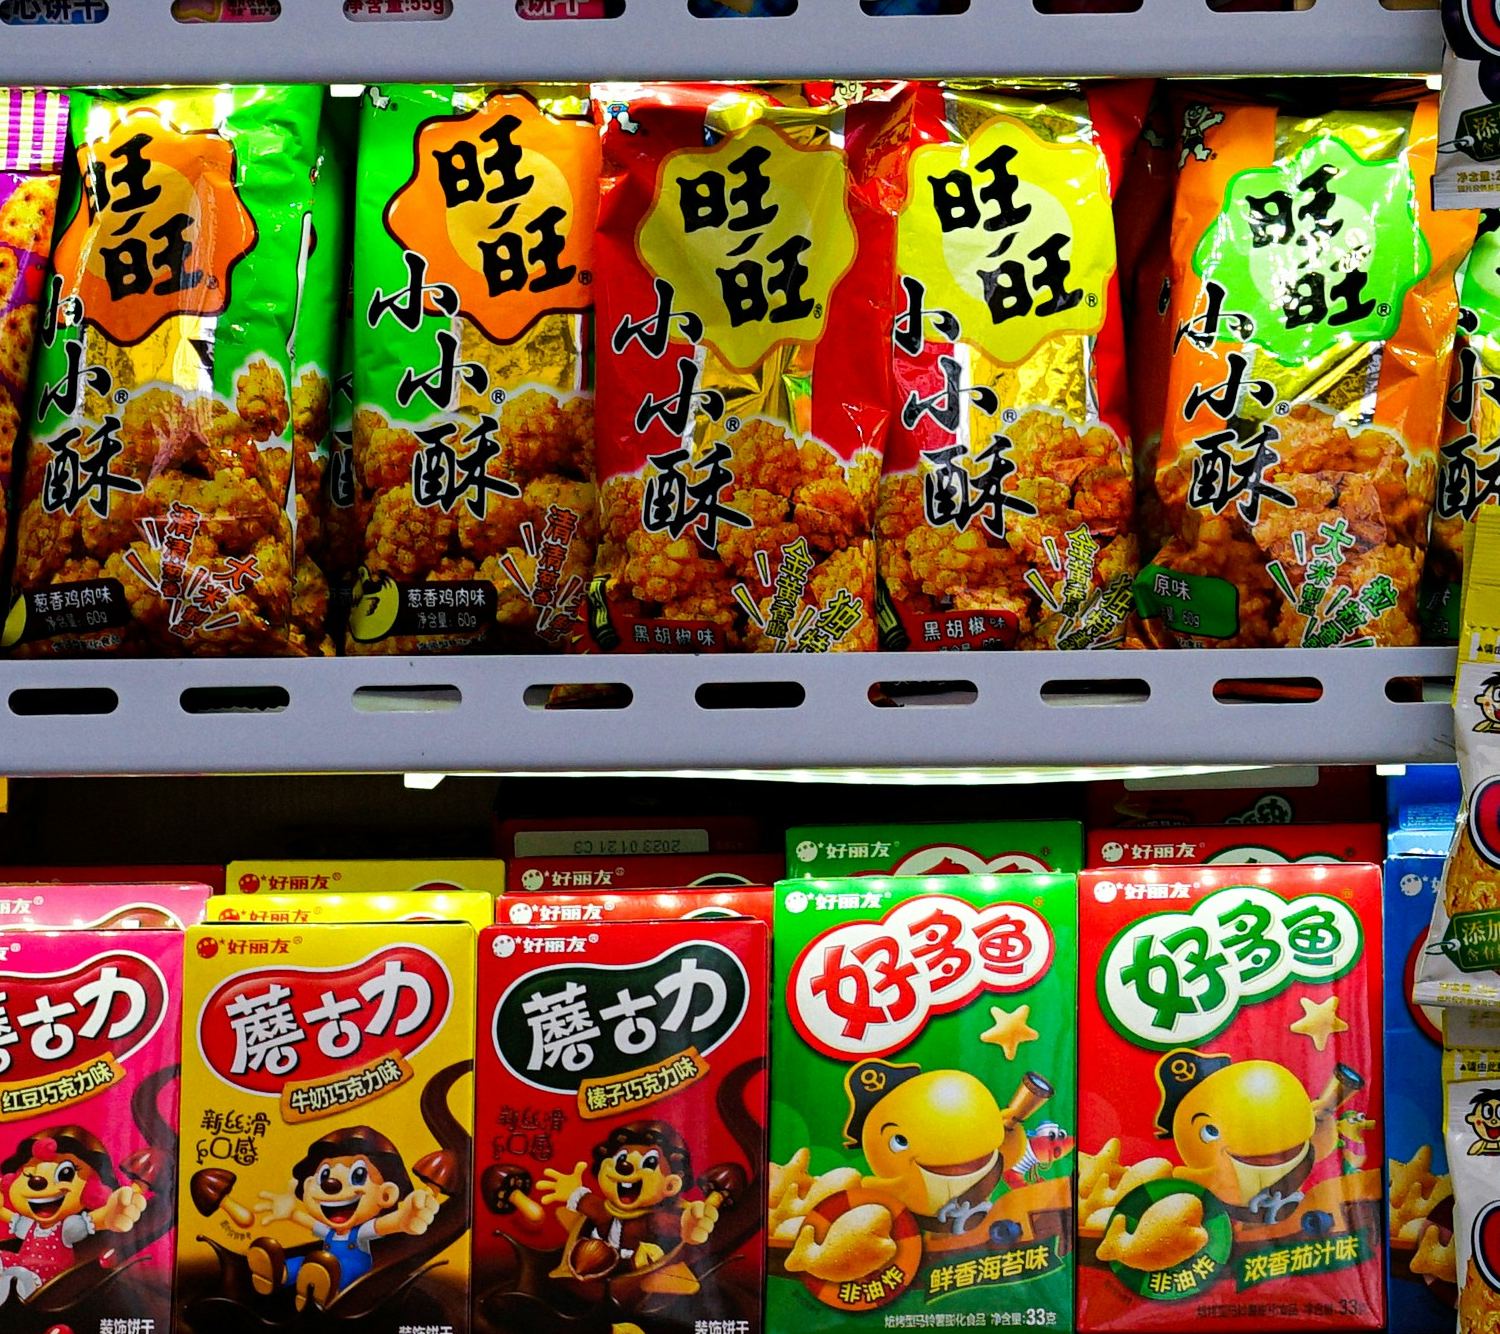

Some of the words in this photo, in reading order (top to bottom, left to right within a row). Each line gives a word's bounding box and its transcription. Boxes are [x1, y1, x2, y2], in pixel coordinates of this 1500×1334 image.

[432, 115, 578, 297] 旺旺
[408, 586, 487, 608] 葱香鸡肉味
[633, 625, 714, 646] 黑胡椒味
[811, 908, 1035, 1041] 好多鱼
[2, 1064, 113, 1112] 红豆巧克力味
[289, 1059, 402, 1111] 牛奶巧克力味
[585, 1060, 699, 1111] 榛子巧克力味
[929, 1248, 1049, 1292] 鲜香海苔味
[1244, 1238, 1359, 1282] 浓香茄汁味
